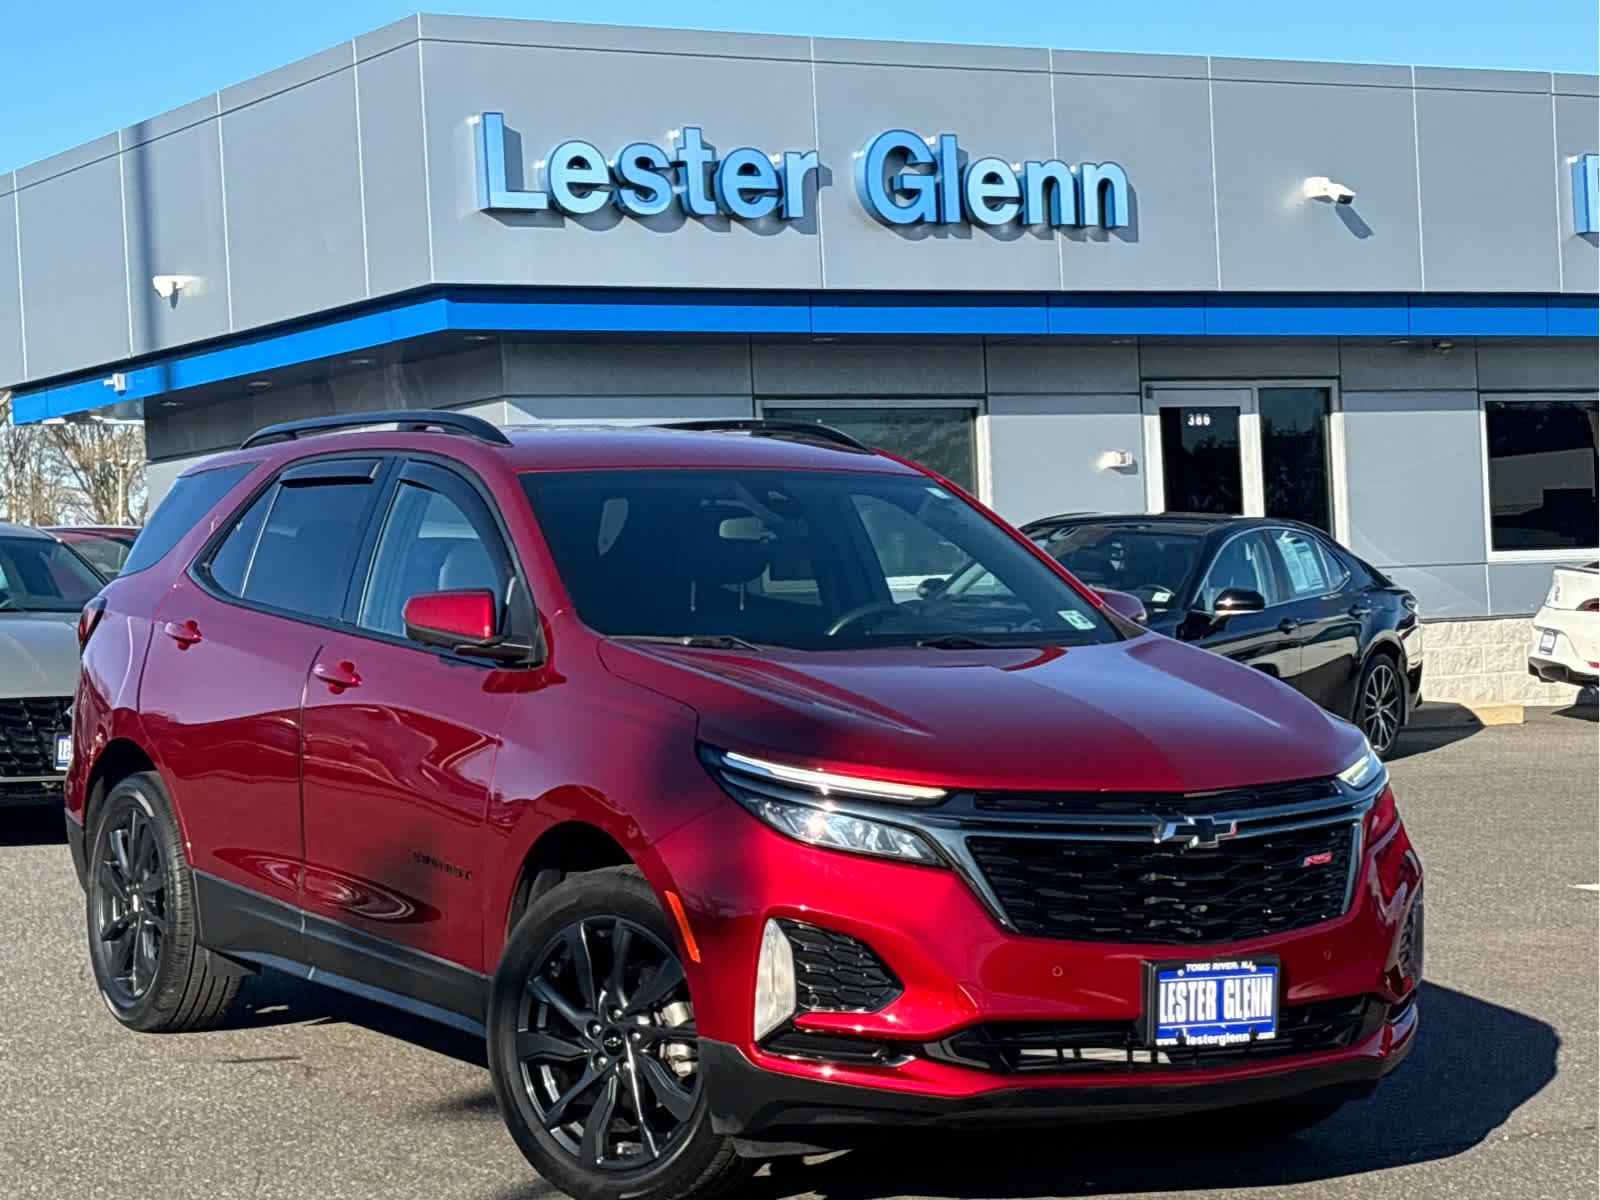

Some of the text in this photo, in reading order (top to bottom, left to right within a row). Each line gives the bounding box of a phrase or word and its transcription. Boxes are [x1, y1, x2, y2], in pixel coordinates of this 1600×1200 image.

[475, 111, 1129, 229] Lester Glenn
[1186, 963, 1211, 972] TOMS
[1159, 977, 1273, 1024] LESTER GLENN
